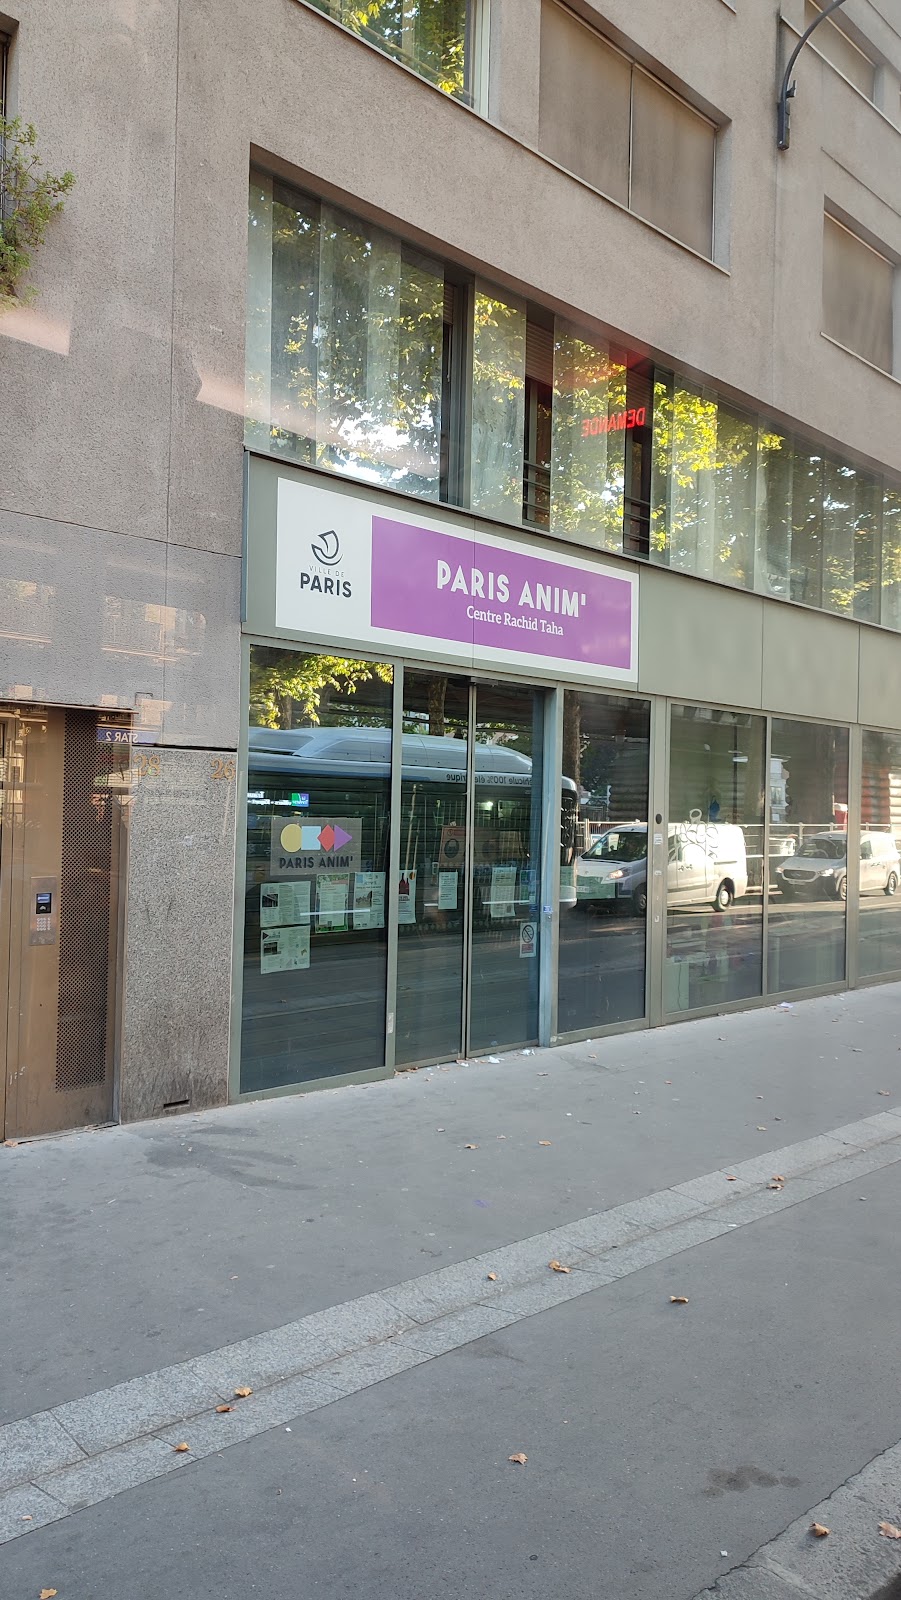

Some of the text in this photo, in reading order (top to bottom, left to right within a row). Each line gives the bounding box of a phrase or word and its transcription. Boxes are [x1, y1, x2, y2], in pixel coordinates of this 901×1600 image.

[309, 565, 331, 575] VILLE
[300, 572, 352, 598] PARIS
[437, 559, 586, 617] PARIS ANIM'
[466, 605, 564, 636] Centre Rachid Taha
[134, 754, 160, 776] 28
[210, 758, 236, 780] 26
[279, 855, 353, 869] PARIS ANIM'
